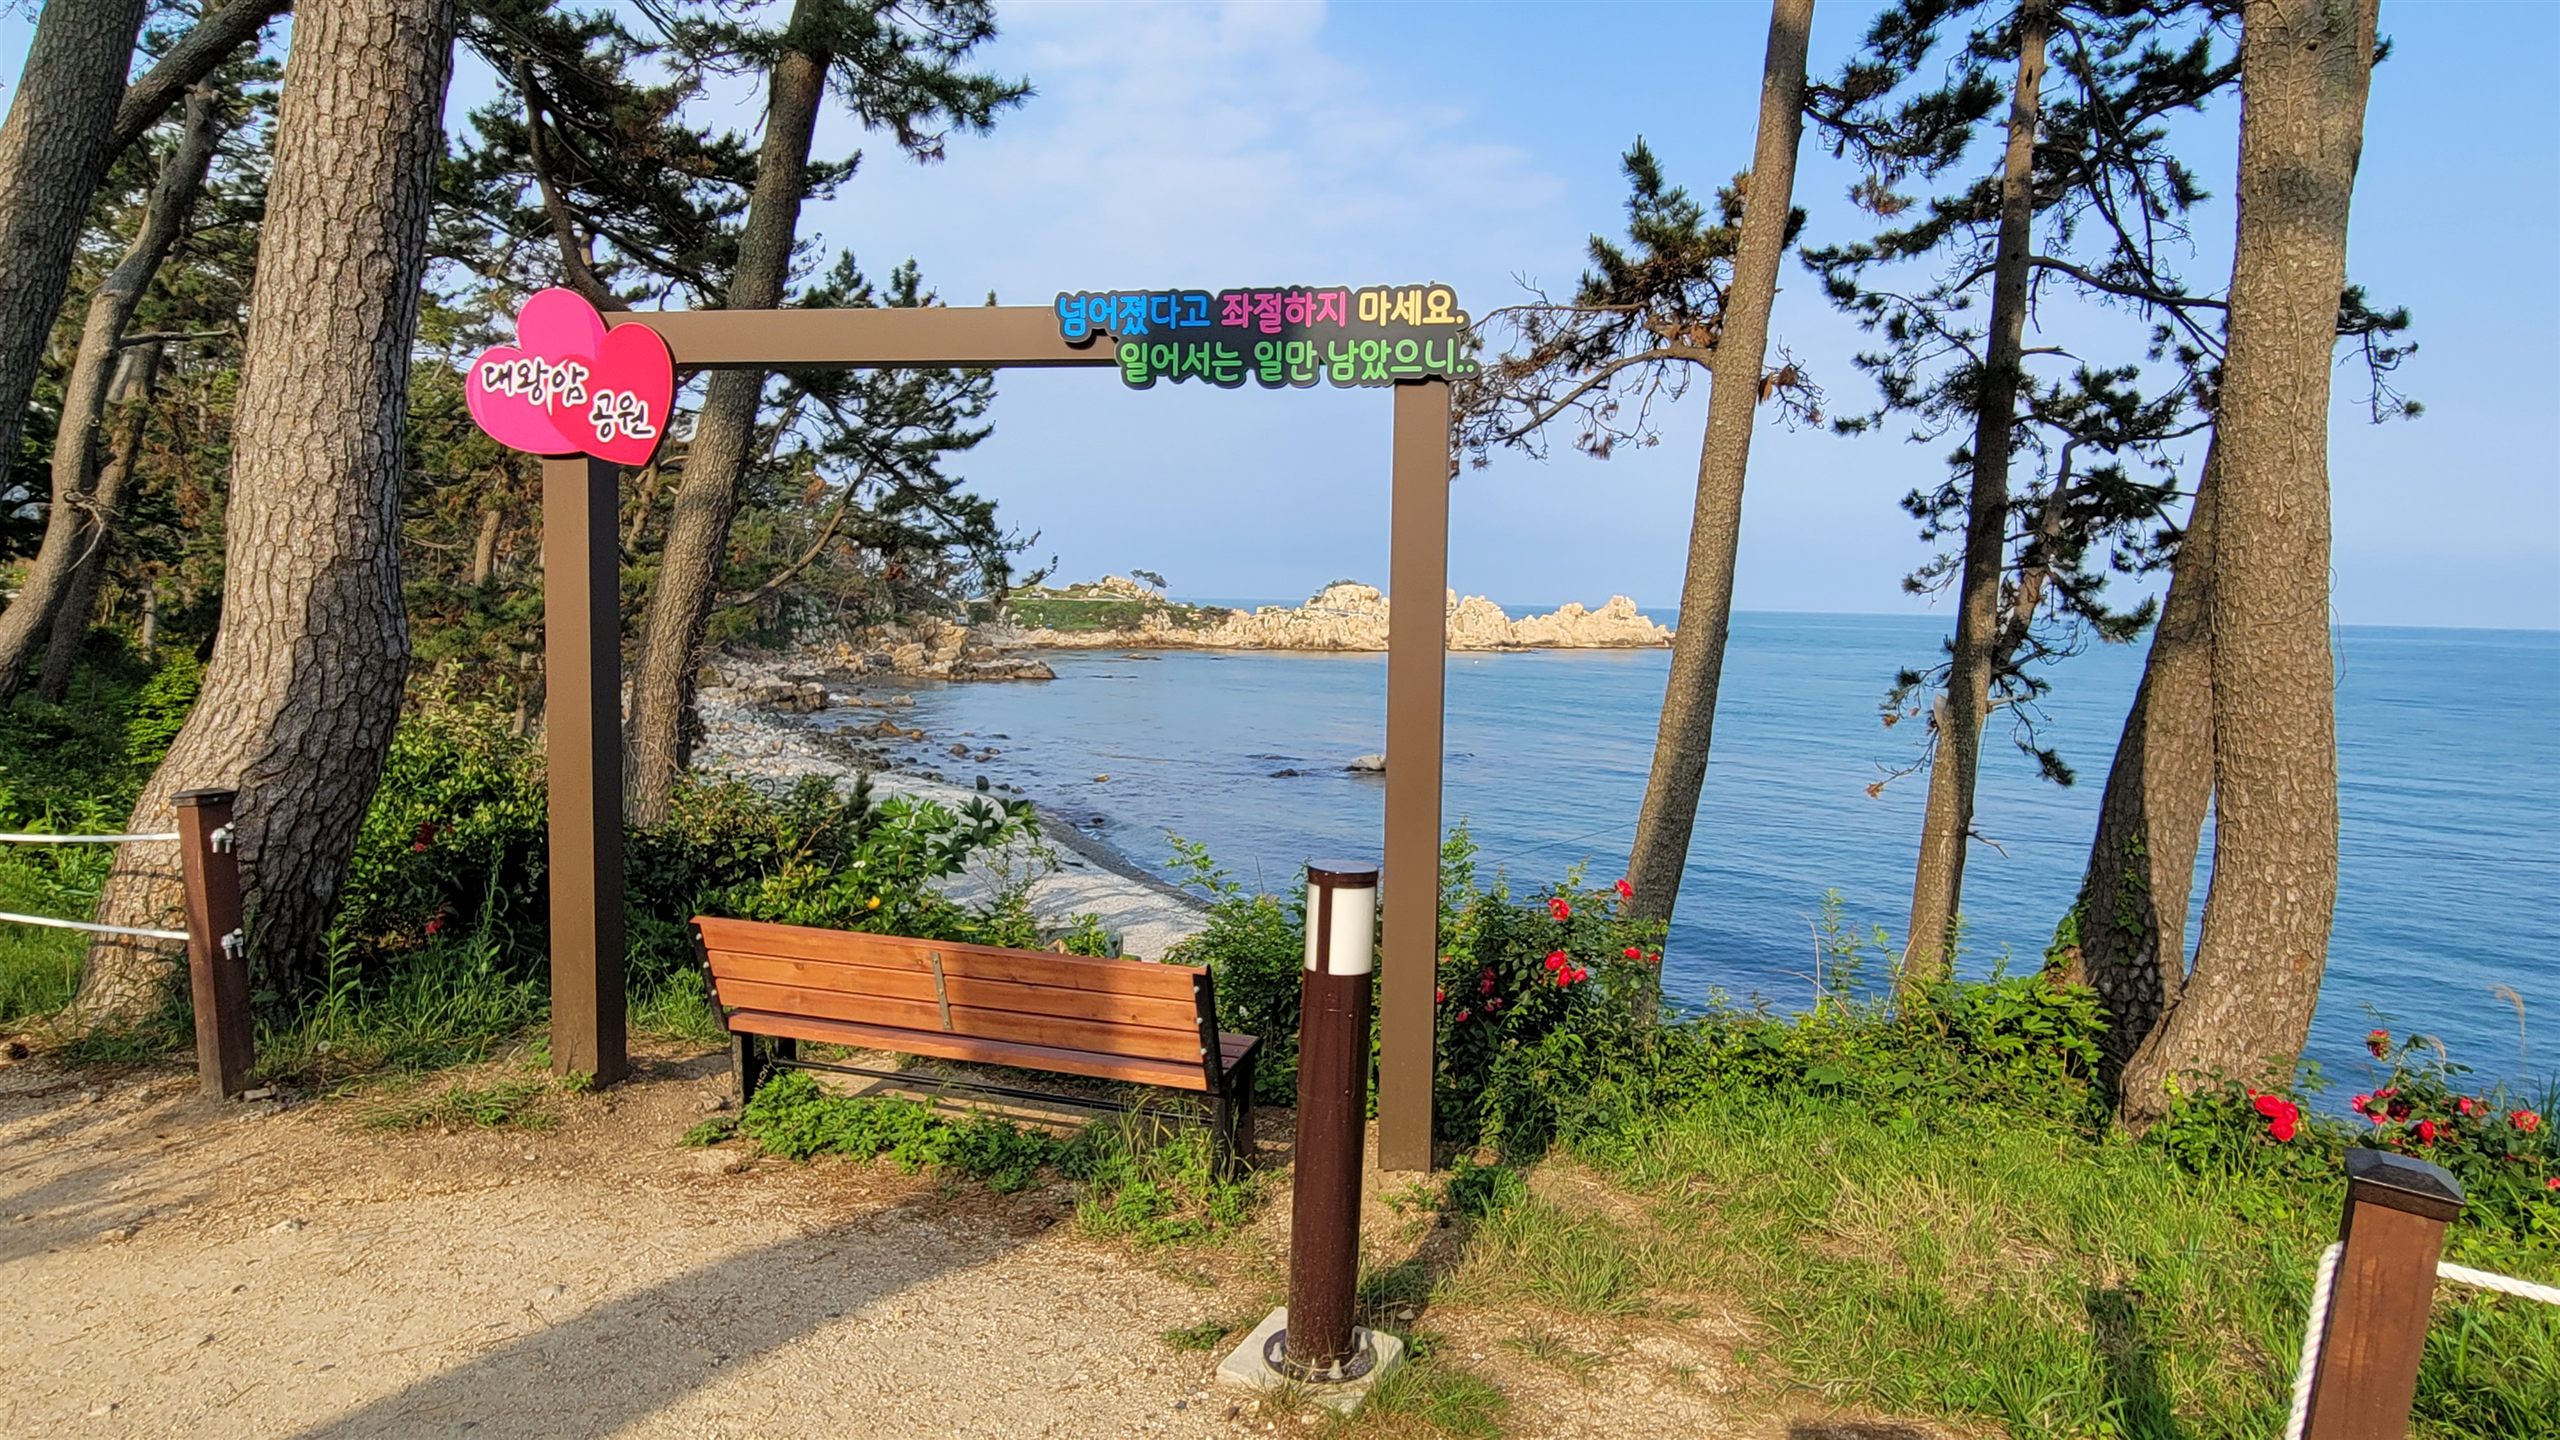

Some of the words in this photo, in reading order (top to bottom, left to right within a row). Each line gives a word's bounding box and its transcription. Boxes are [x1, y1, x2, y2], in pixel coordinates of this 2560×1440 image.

[1059, 293, 1211, 337] 넘어졌다고
[1219, 291, 1346, 335] 좌절하지
[1358, 288, 1465, 328] 마세요.
[482, 358, 589, 406] 대왕암
[1119, 340, 1243, 383] 일어서는
[1253, 339, 1318, 381] 일만
[1327, 338, 1475, 382] 남았으니..
[589, 389, 655, 441] 공원
